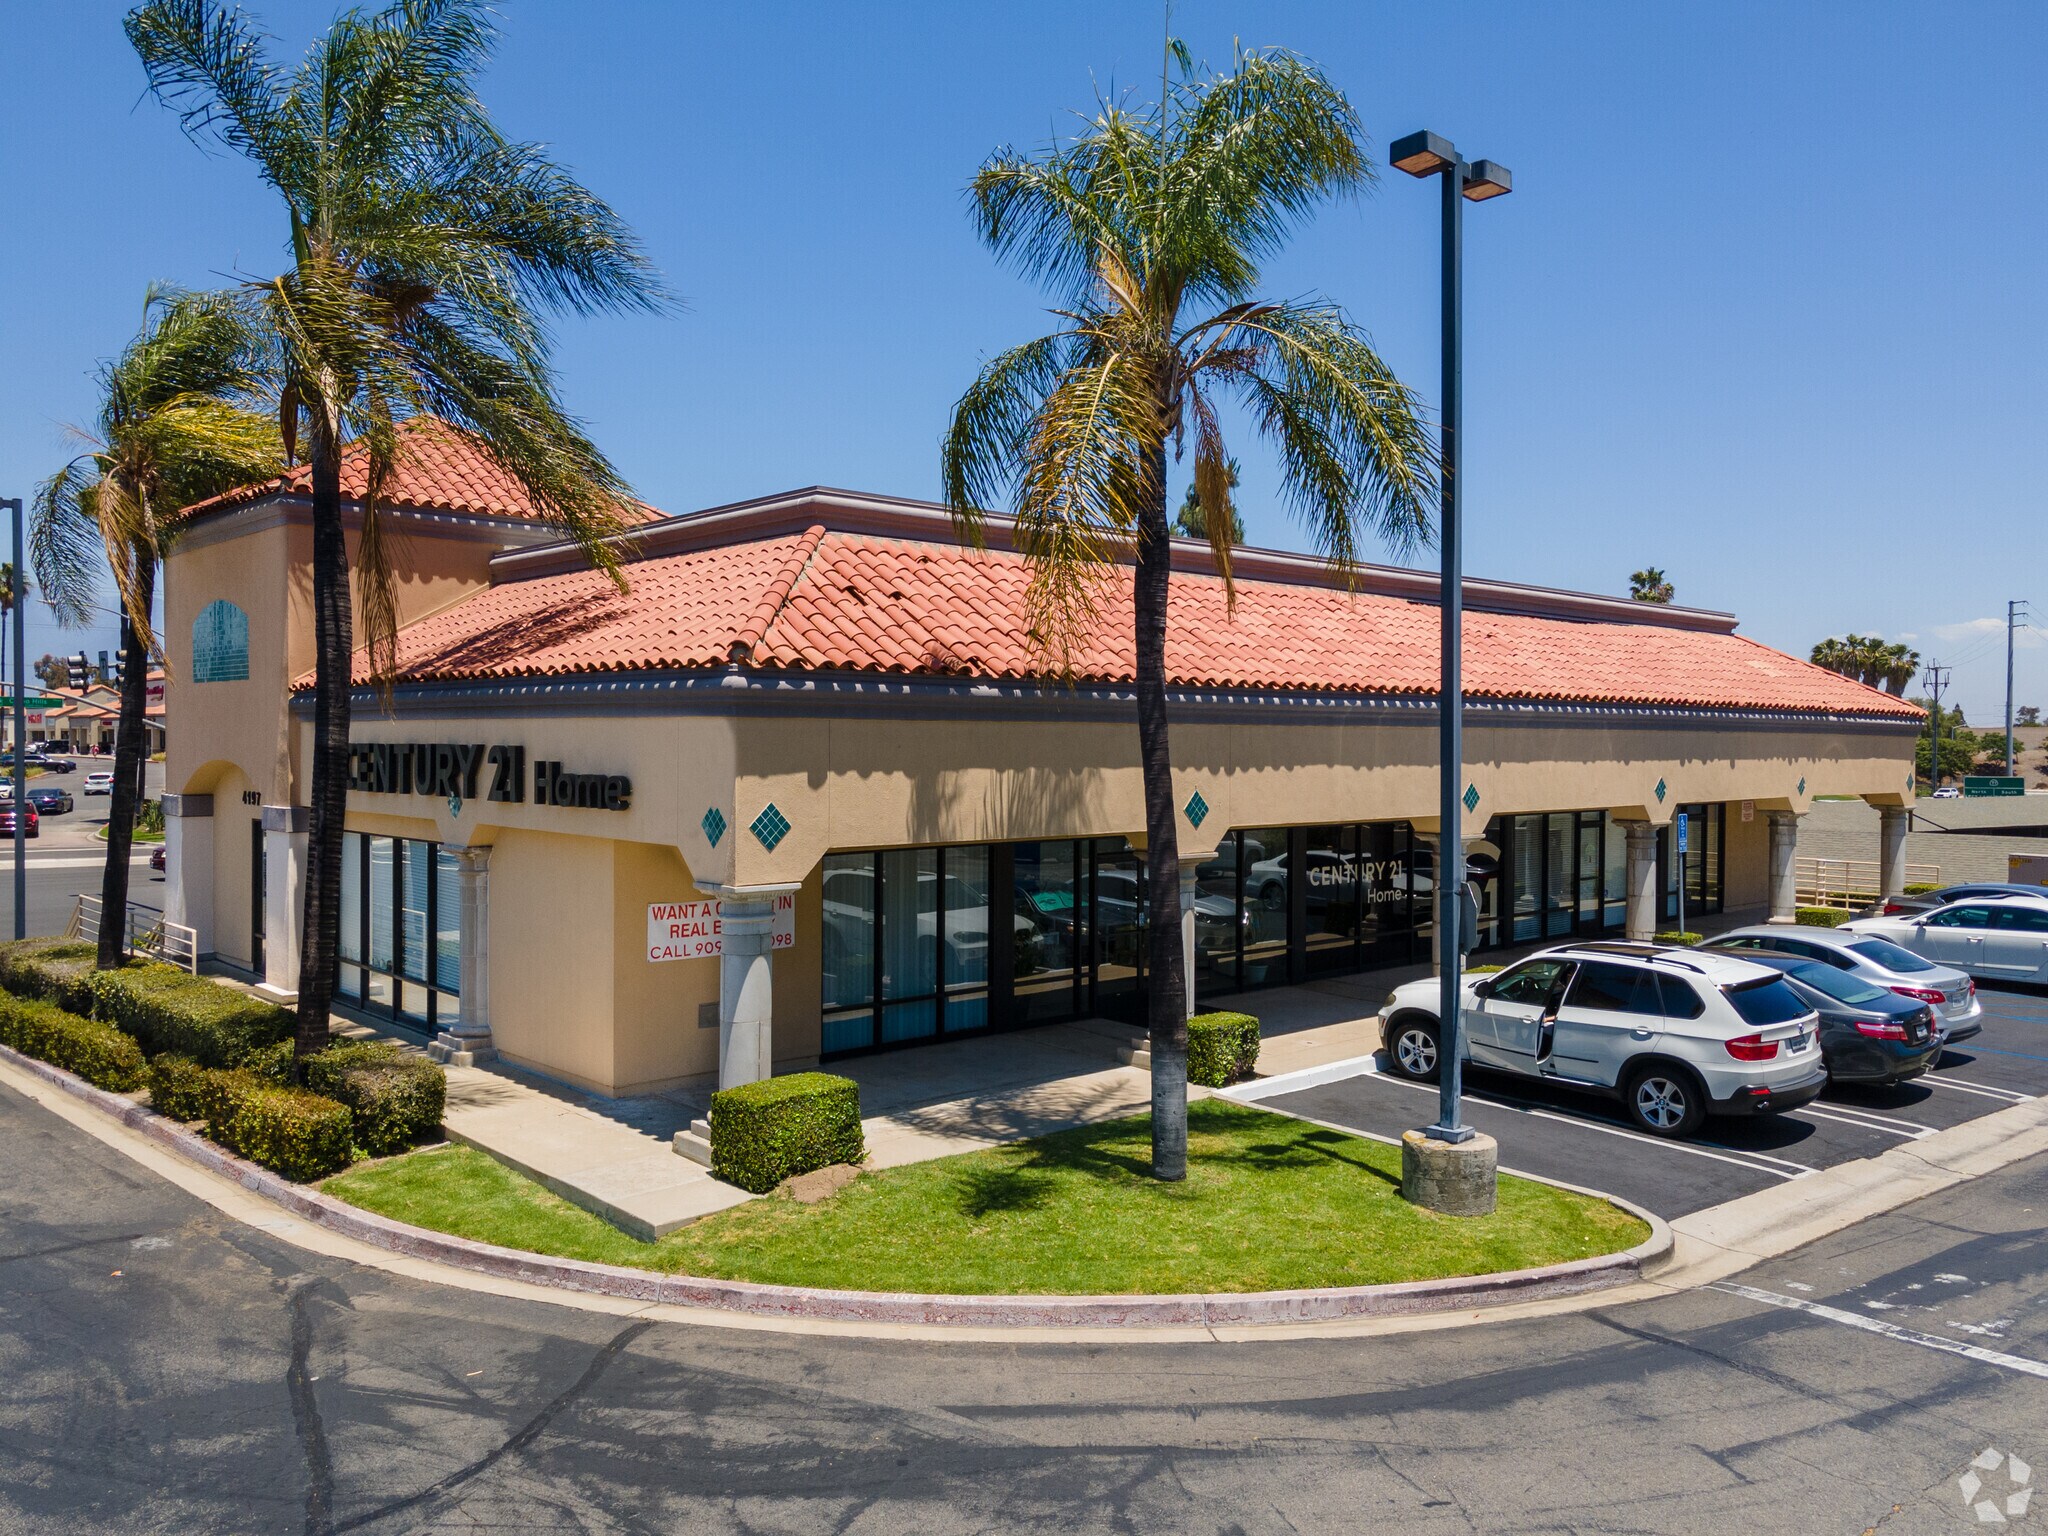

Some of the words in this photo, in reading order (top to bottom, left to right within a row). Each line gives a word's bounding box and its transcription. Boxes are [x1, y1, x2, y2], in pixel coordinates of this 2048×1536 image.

[487, 745, 523, 802] 21
[534, 761, 631, 811] Home
[242, 790, 261, 806] 4197
[1309, 862, 1386, 886] CENTURY
[1389, 860, 1402, 879] 21
[1367, 888, 1402, 904] Home
[652, 903, 698, 920] WANT
[702, 902, 711, 917] A
[778, 895, 792, 910] IN
[670, 920, 708, 938] REAL
[650, 944, 691, 959] CALL
